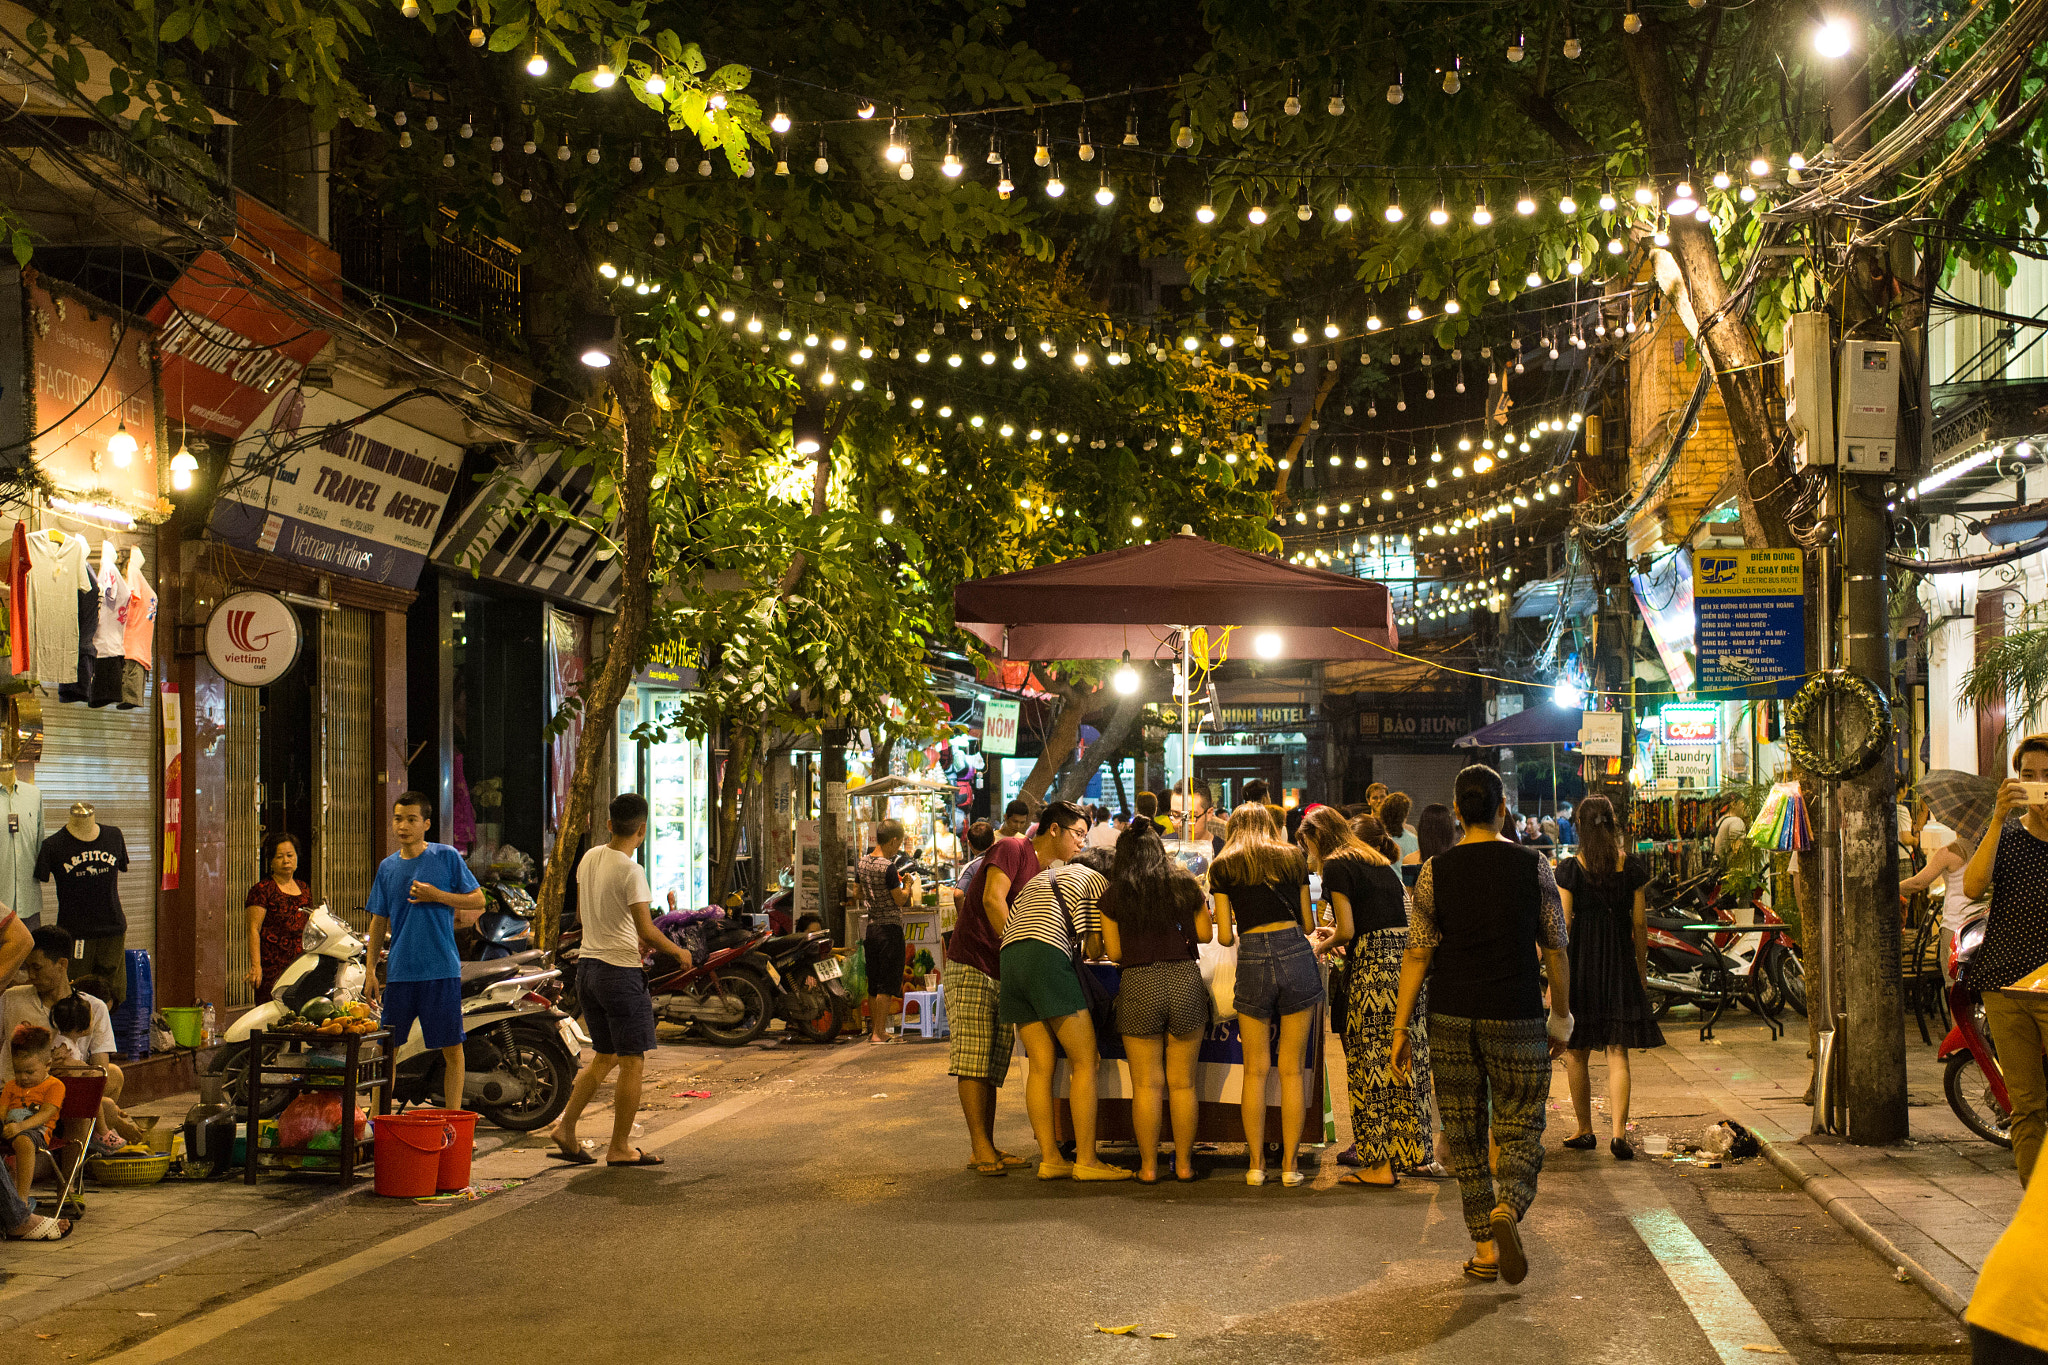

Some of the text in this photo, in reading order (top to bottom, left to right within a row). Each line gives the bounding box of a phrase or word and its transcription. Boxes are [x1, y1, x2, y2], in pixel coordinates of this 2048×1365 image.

[157, 310, 302, 394] VIETTIME CRAFT
[38, 361, 147, 428] FACTORY OUTLET
[314, 466, 440, 529] TRAVEL AGENT
[290, 525, 332, 562] Vietnam
[336, 538, 373, 572] Airlines
[1746, 566, 1755, 574] XE
[1780, 576, 1798, 584] ROUTE
[225, 652, 267, 665] viettime
[1221, 709, 1257, 723] HINH
[1262, 708, 1307, 723] HOTEL
[1670, 723, 1711, 738] Coffee
[1204, 735, 1269, 746] TRAVEL AGENT
[1668, 749, 1711, 766] Laundry
[1676, 765, 1710, 775] 20.000vnd
